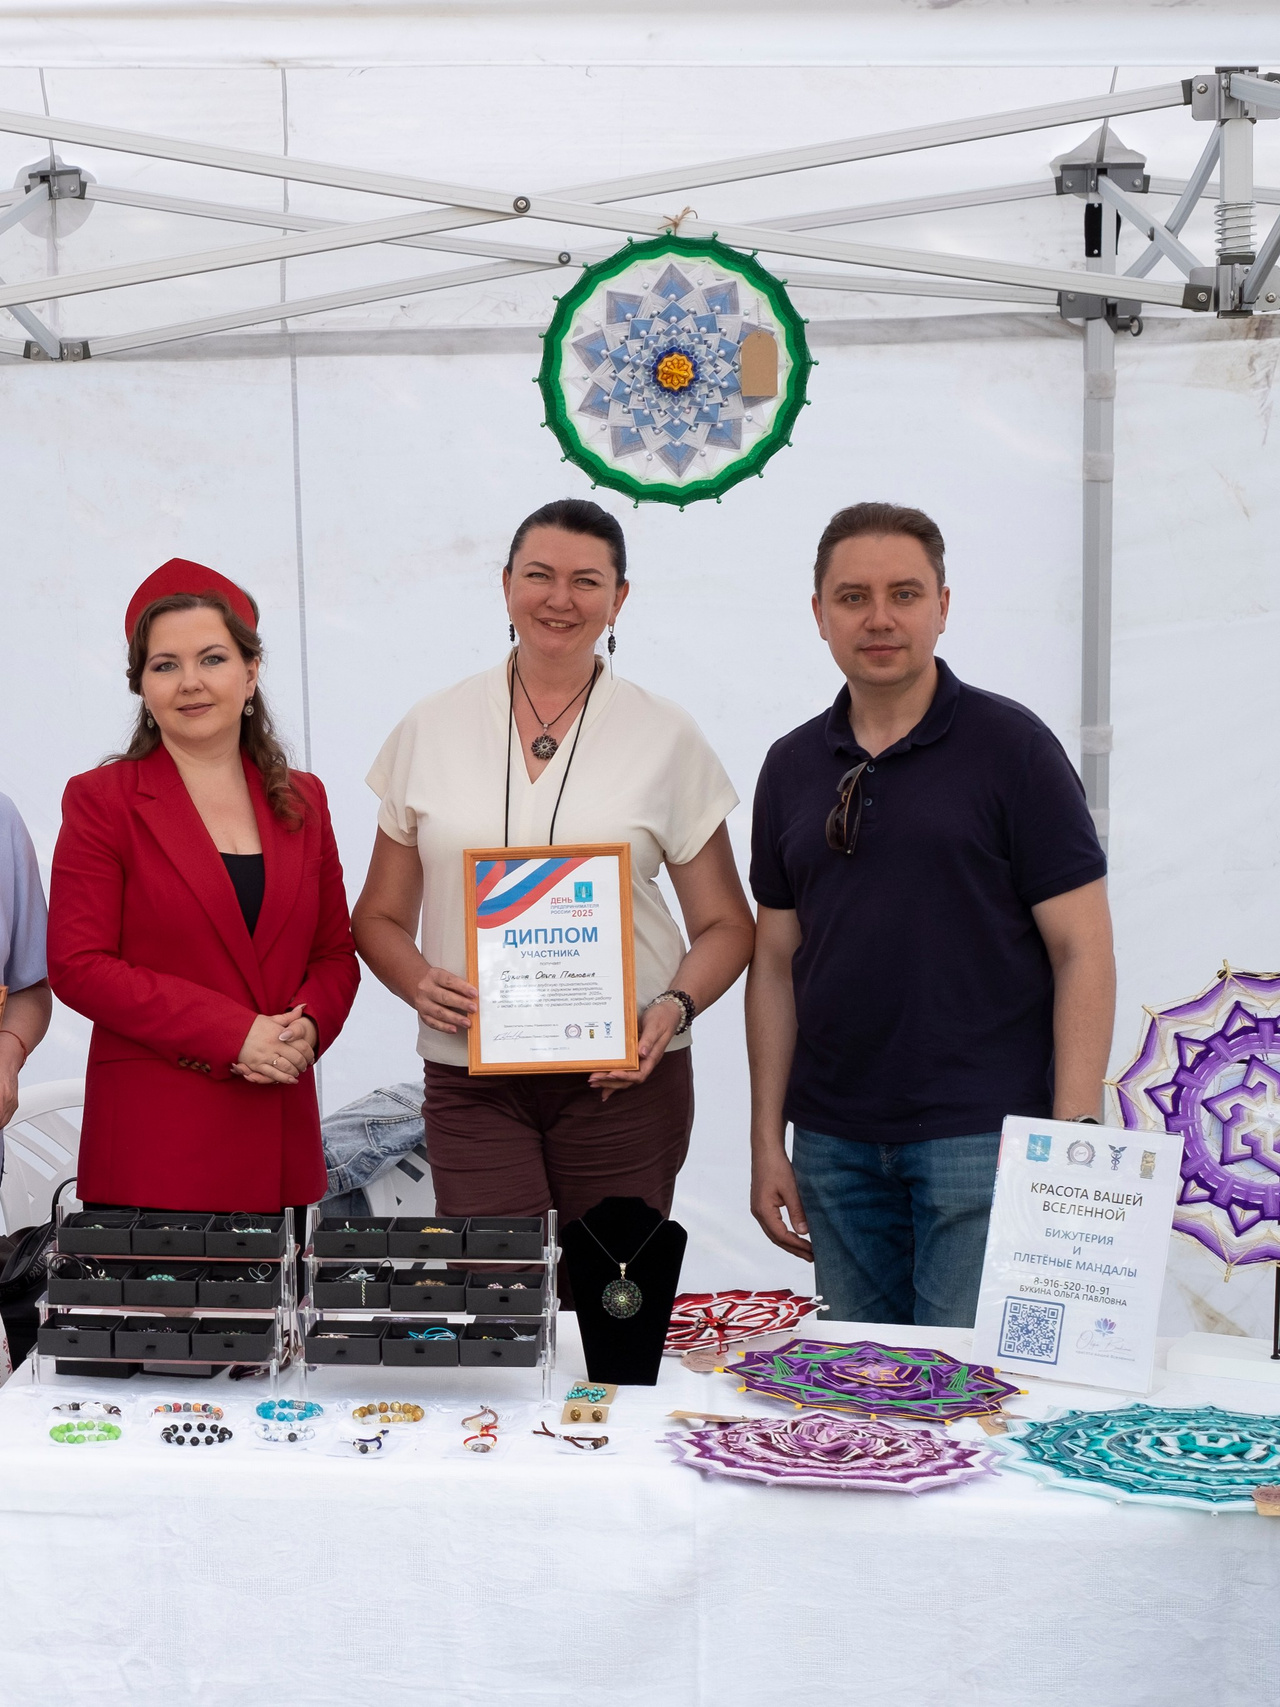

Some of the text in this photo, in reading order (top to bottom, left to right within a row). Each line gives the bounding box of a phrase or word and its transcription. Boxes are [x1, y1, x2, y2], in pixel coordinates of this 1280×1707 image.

[572, 909, 594, 917] 2025
[502, 926, 598, 948] ДИПЛОМ
[520, 949, 580, 959] УЧАСТНИКА
[1030, 1182, 1143, 1206] КРАСОТА ВАШЕЙ
[1042, 1200, 1126, 1222] ВСЕЛЕННОЙ
[1045, 1228, 1114, 1245] БИЖУТЕРИЯ
[1072, 1246, 1082, 1255] И
[1014, 1252, 1137, 1278] ПЛЕТЁНЫЕ МАНДАЛЫ
[1020, 1284, 1127, 1306] БУКИНА ОЛЬГА ПАВЛОВНА
[1034, 1276, 1110, 1295] 8-916-520-10-91
